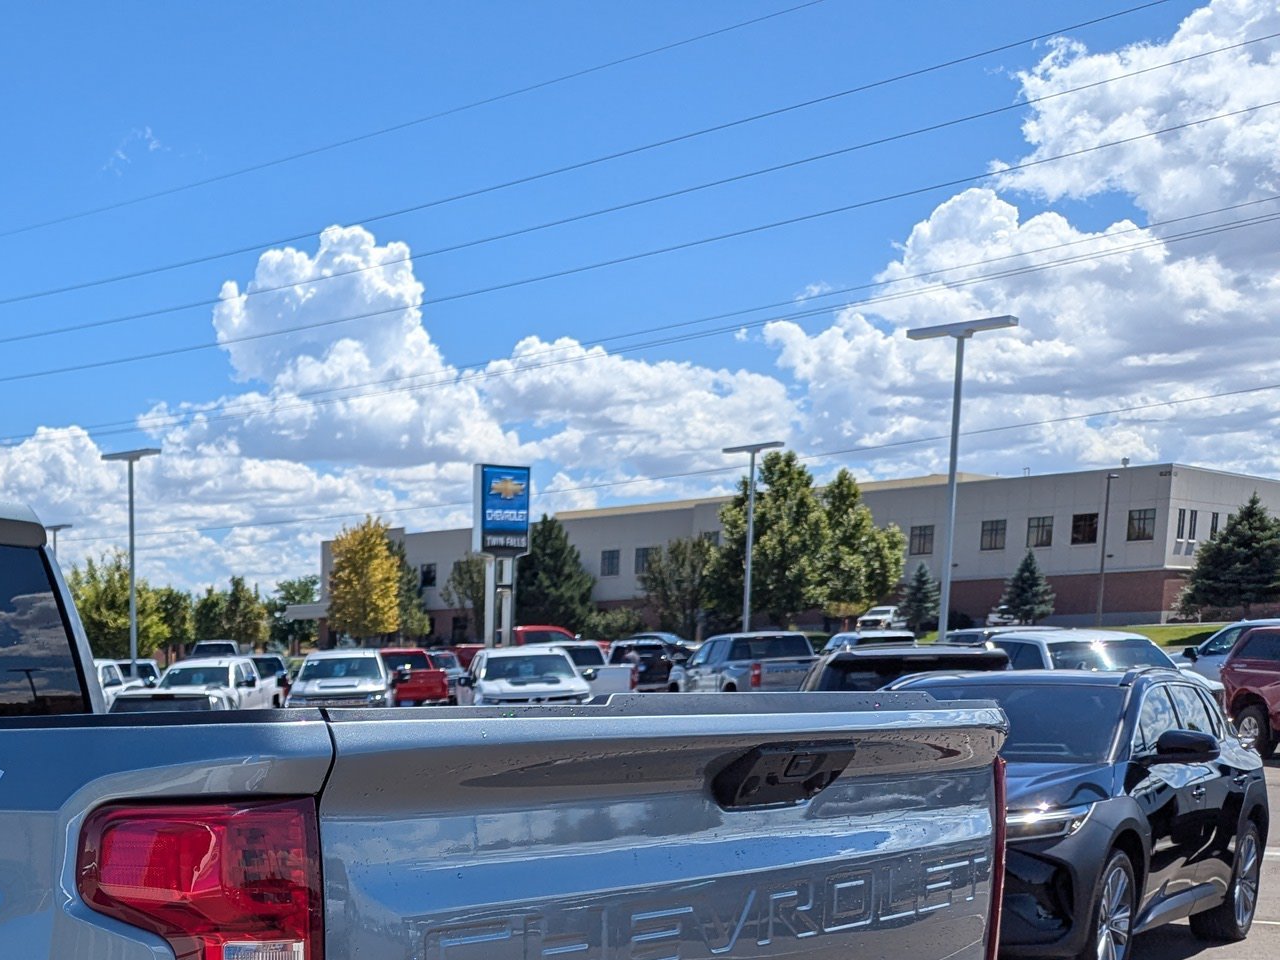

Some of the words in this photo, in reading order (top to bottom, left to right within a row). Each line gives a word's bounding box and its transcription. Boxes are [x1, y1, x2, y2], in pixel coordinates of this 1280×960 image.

[486, 509, 528, 521] CHEVROLET
[487, 536, 505, 547] TWIN
[506, 536, 527, 548] FALLS
